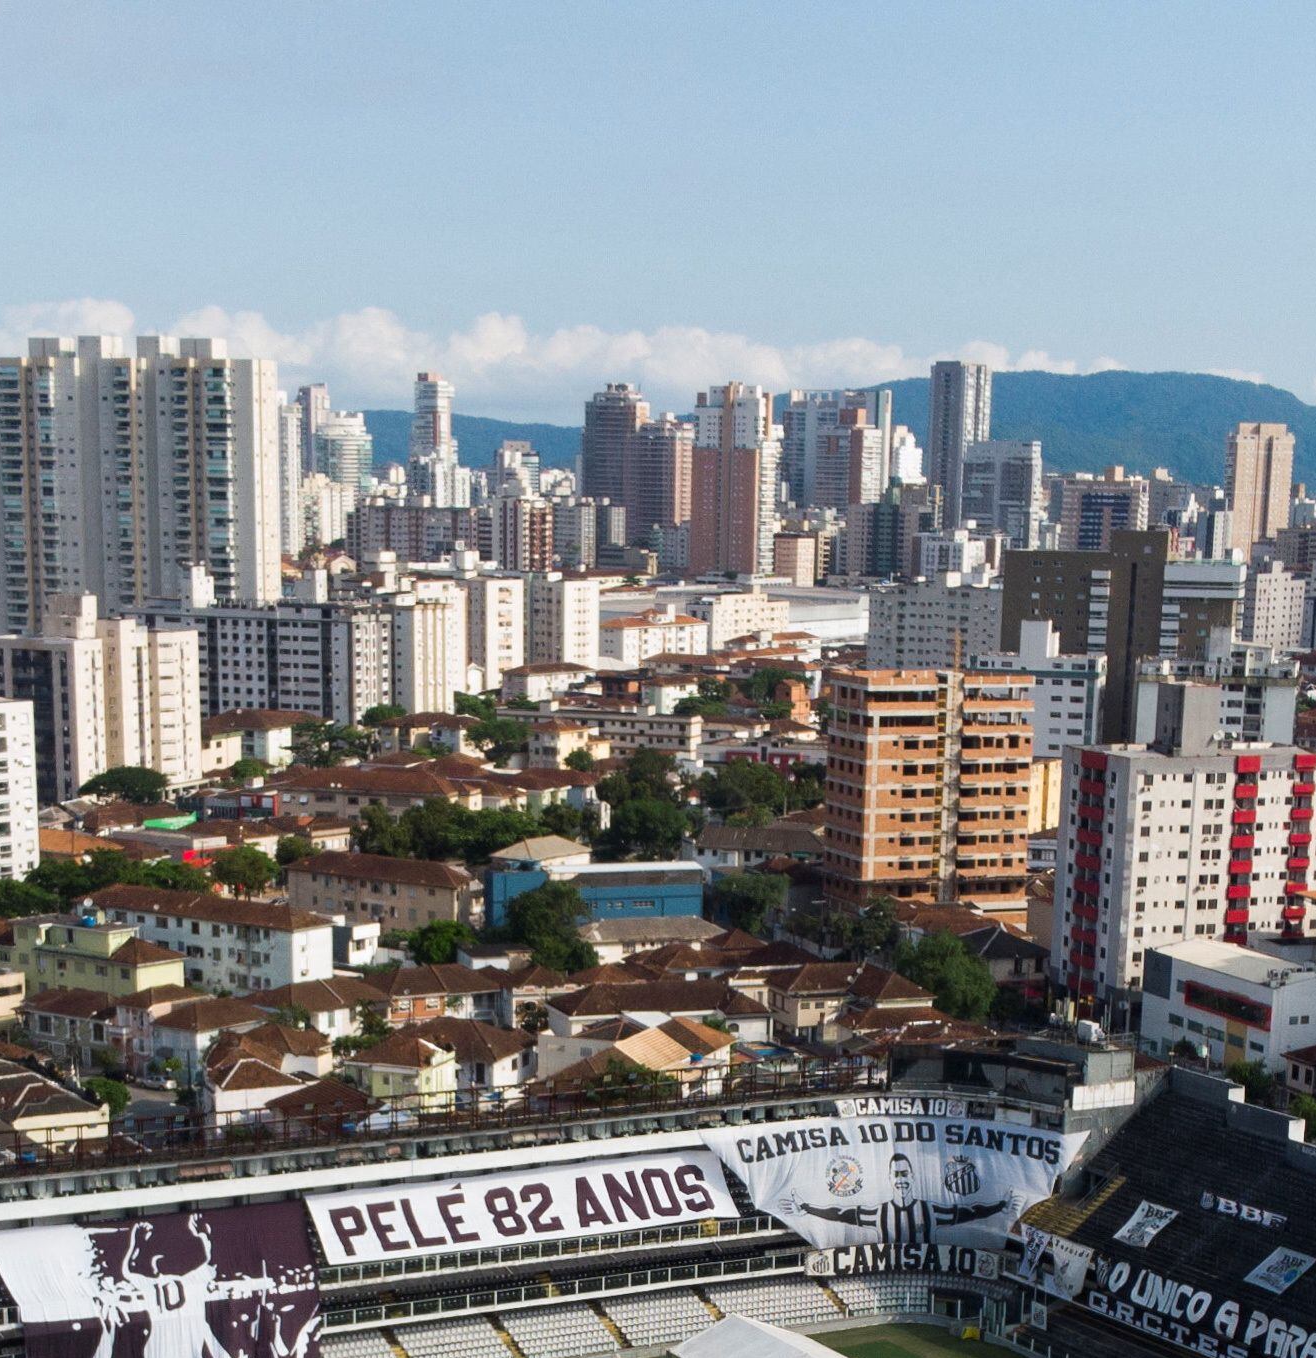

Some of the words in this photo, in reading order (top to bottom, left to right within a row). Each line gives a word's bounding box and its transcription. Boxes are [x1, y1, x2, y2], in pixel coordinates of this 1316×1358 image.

[855, 1098, 933, 1116] CAMISA
[934, 1099, 946, 1116] 10
[736, 1125, 850, 1164] CAMISA
[858, 1123, 888, 1144] 10
[894, 1122, 936, 1143] DO
[945, 1124, 1061, 1165] SANTOS
[329, 1183, 480, 1257] PELÉ
[490, 1186, 563, 1238] 82
[576, 1164, 715, 1227] ANOS
[1217, 1197, 1287, 1229] BBF
[833, 1244, 943, 1274] CAMISA
[948, 1245, 977, 1275] 10
[156, 1279, 183, 1313] 10
[1108, 1261, 1131, 1293] O
[1214, 1300, 1240, 1339] A
